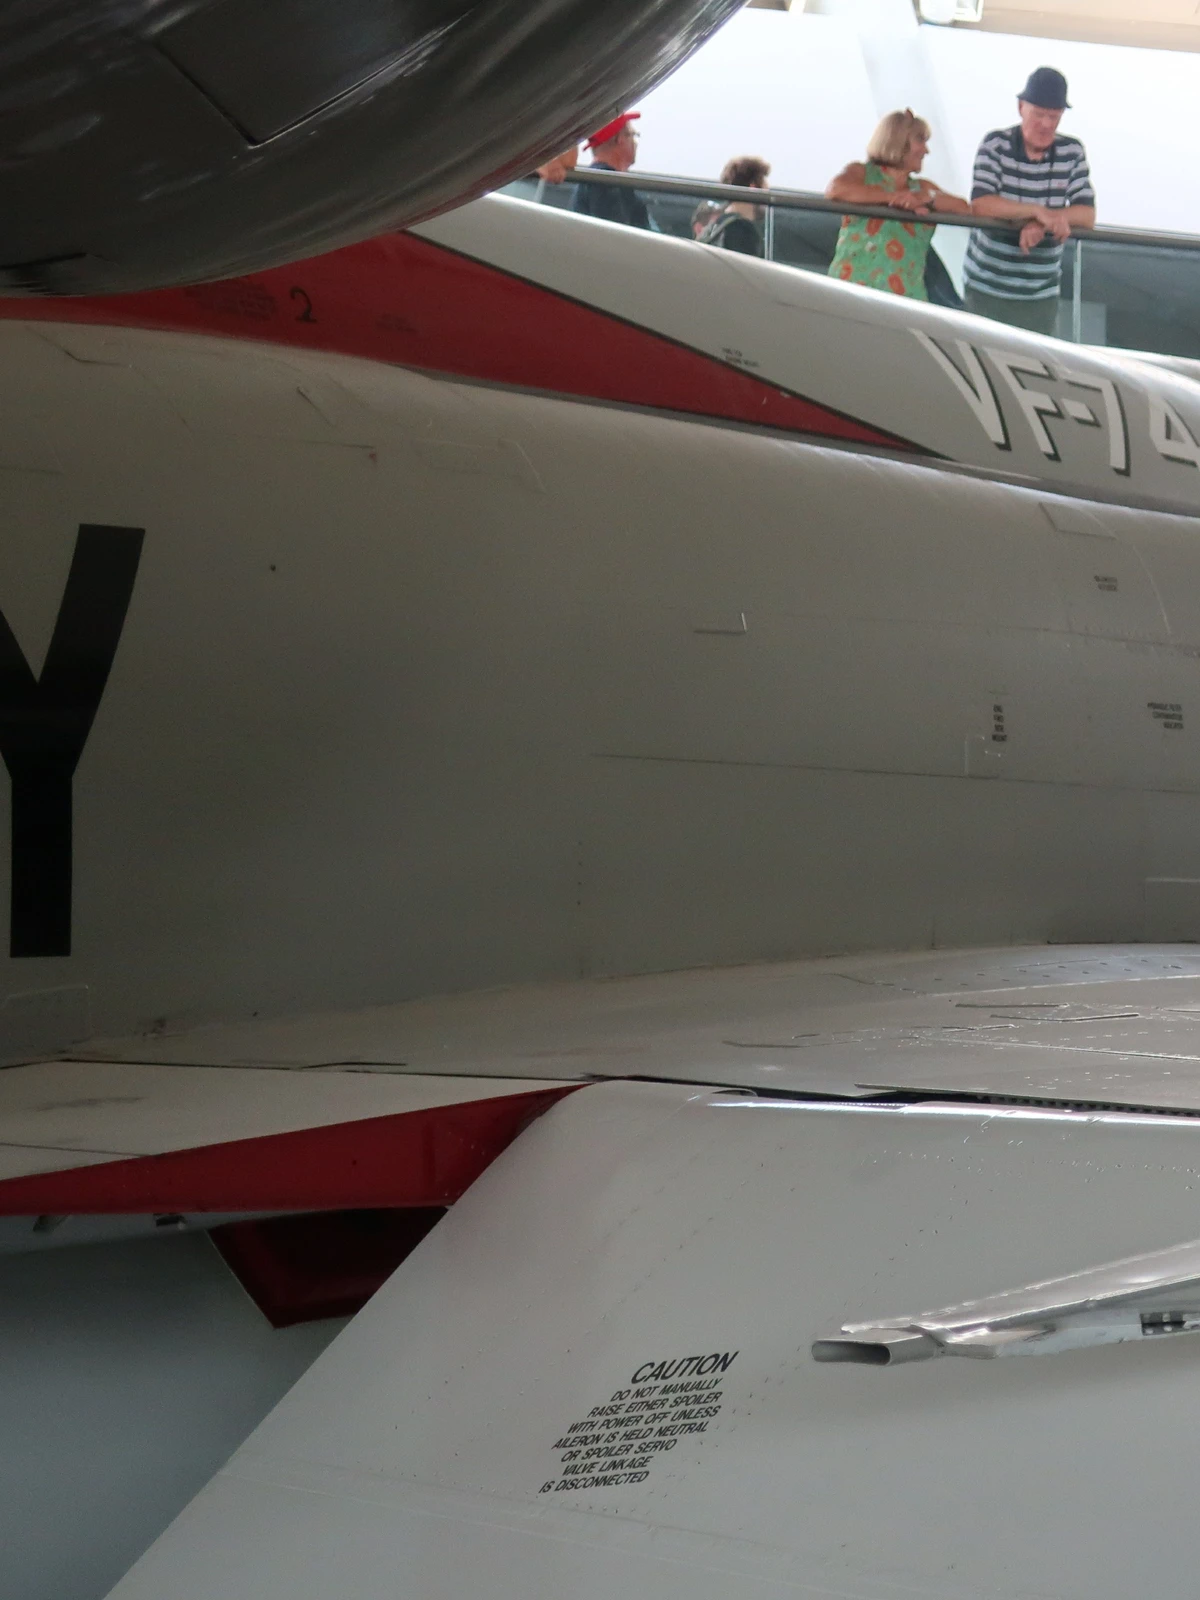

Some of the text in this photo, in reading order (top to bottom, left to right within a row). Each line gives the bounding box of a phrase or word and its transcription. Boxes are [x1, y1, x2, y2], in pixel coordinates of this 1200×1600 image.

[289, 286, 319, 323] 2
[0, 523, 145, 958] Y
[631, 1350, 740, 1384] CAUTION
[610, 1378, 723, 1402] DO NOT MANUALLY
[587, 1391, 723, 1418] RAISE EITHER SPOILER
[567, 1405, 722, 1434] WITH POWER OFF UNLESS
[551, 1421, 709, 1450] AILERON IS HELD NEUTRAL
[561, 1439, 678, 1463] OR SPOILER SERVO
[562, 1456, 654, 1477] VALVE LINKAGE
[538, 1470, 650, 1494] IS DISCONNECTED
